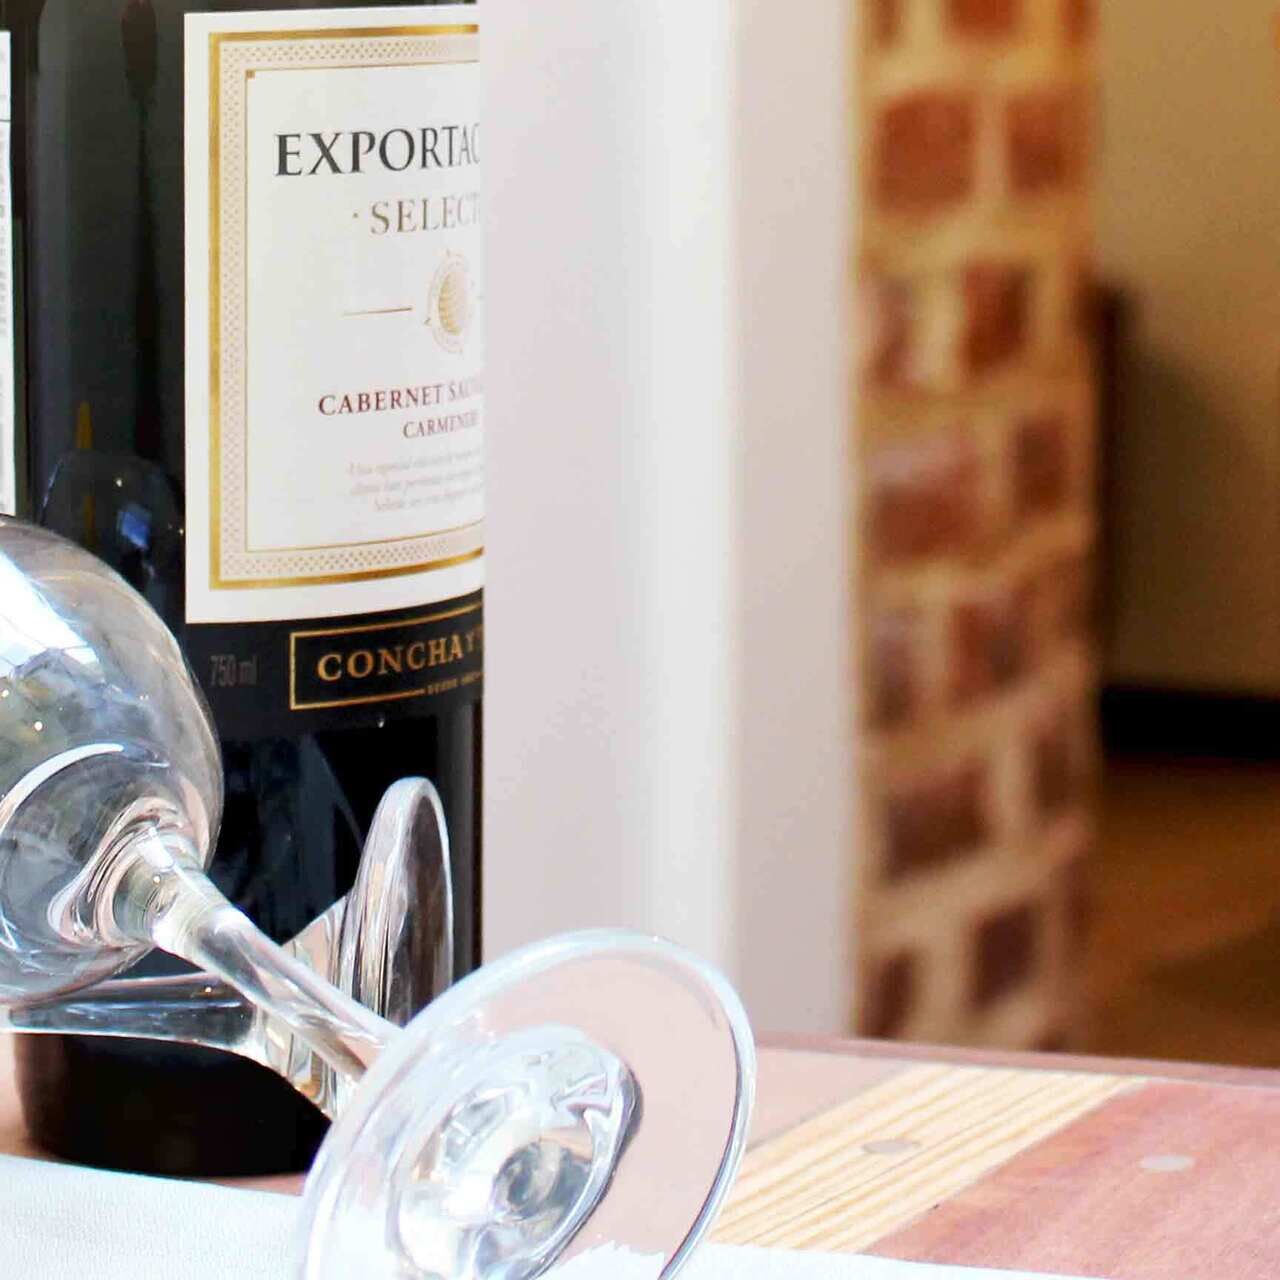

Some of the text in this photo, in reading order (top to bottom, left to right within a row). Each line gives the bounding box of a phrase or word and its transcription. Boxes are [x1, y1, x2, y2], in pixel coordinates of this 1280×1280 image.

[318, 383, 443, 416] CABERNET
[209, 654, 236, 687] 750
[316, 633, 464, 682] CONCHA
